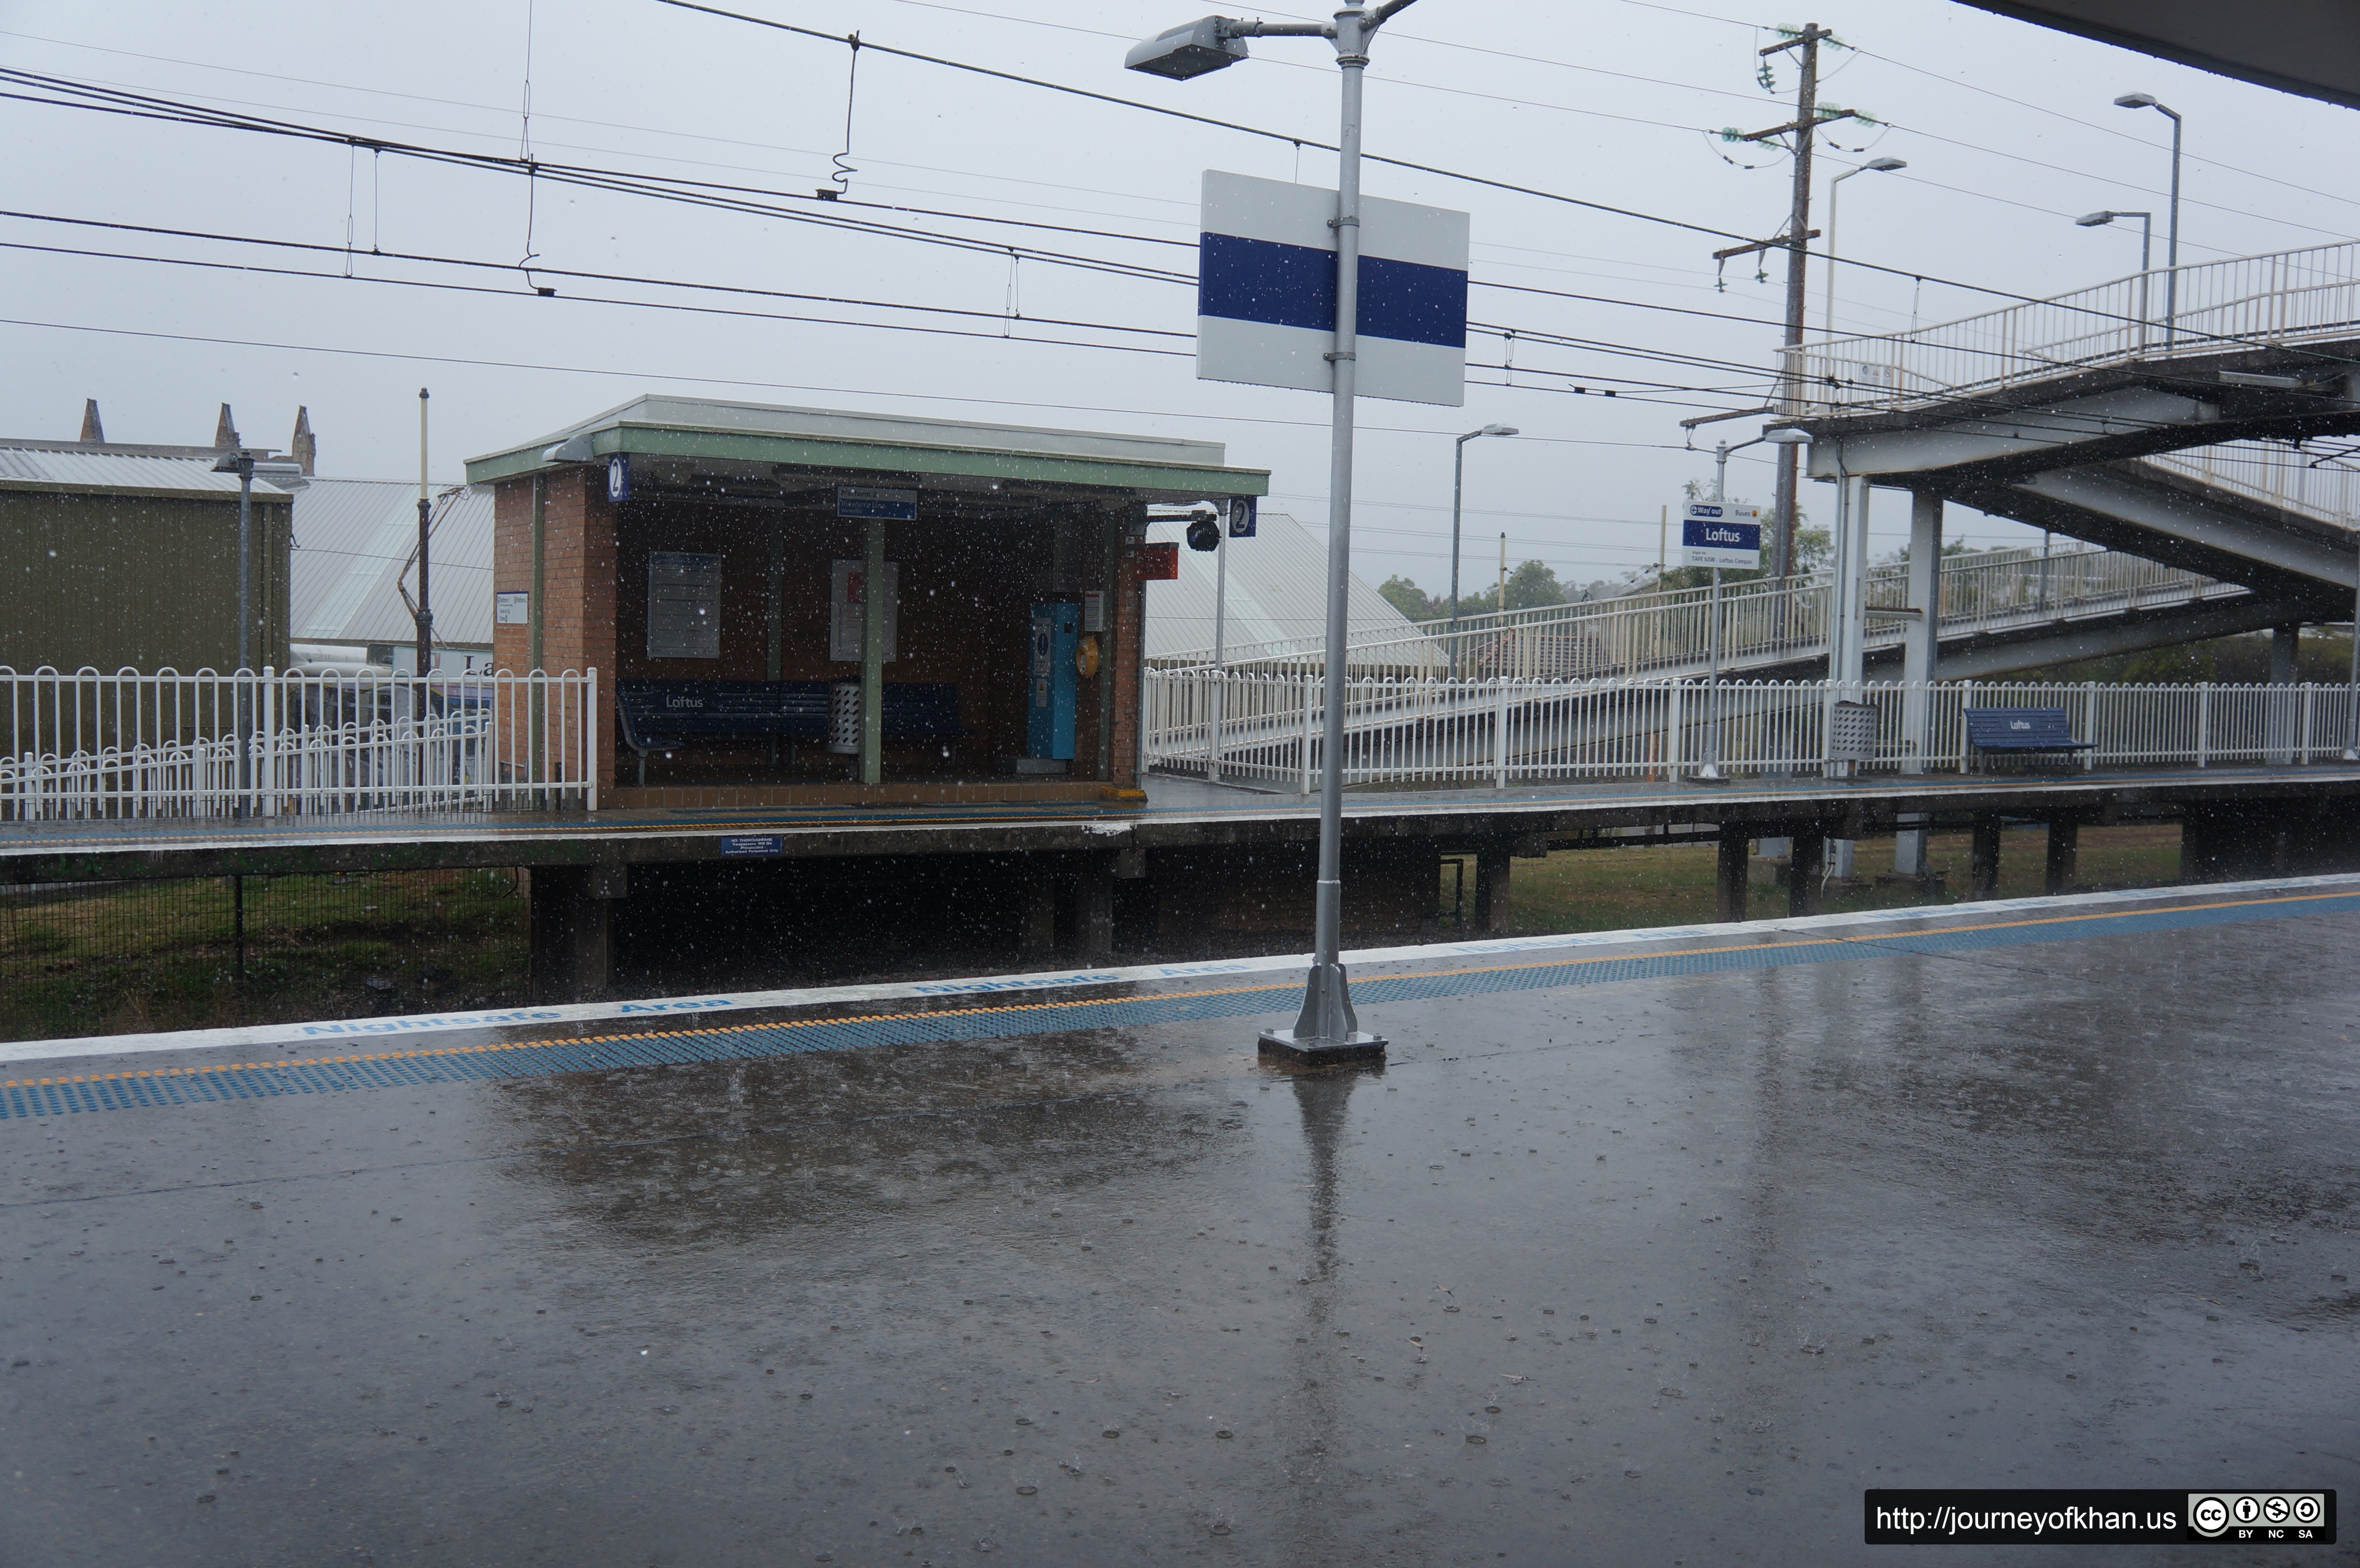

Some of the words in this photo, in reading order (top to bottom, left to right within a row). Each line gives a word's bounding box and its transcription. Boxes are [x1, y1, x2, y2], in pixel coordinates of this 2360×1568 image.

[1236, 503, 1245, 528] 2
[1697, 507, 1710, 515] Way
[1706, 528, 1740, 542] Loftus
[666, 695, 703, 708] Loftus
[2010, 720, 2030, 730] Loftus
[913, 974, 1120, 993] Nightsafe
[1159, 966, 1253, 976] Area
[302, 1012, 562, 1035] Nightsafe
[622, 1000, 734, 1013] Area
